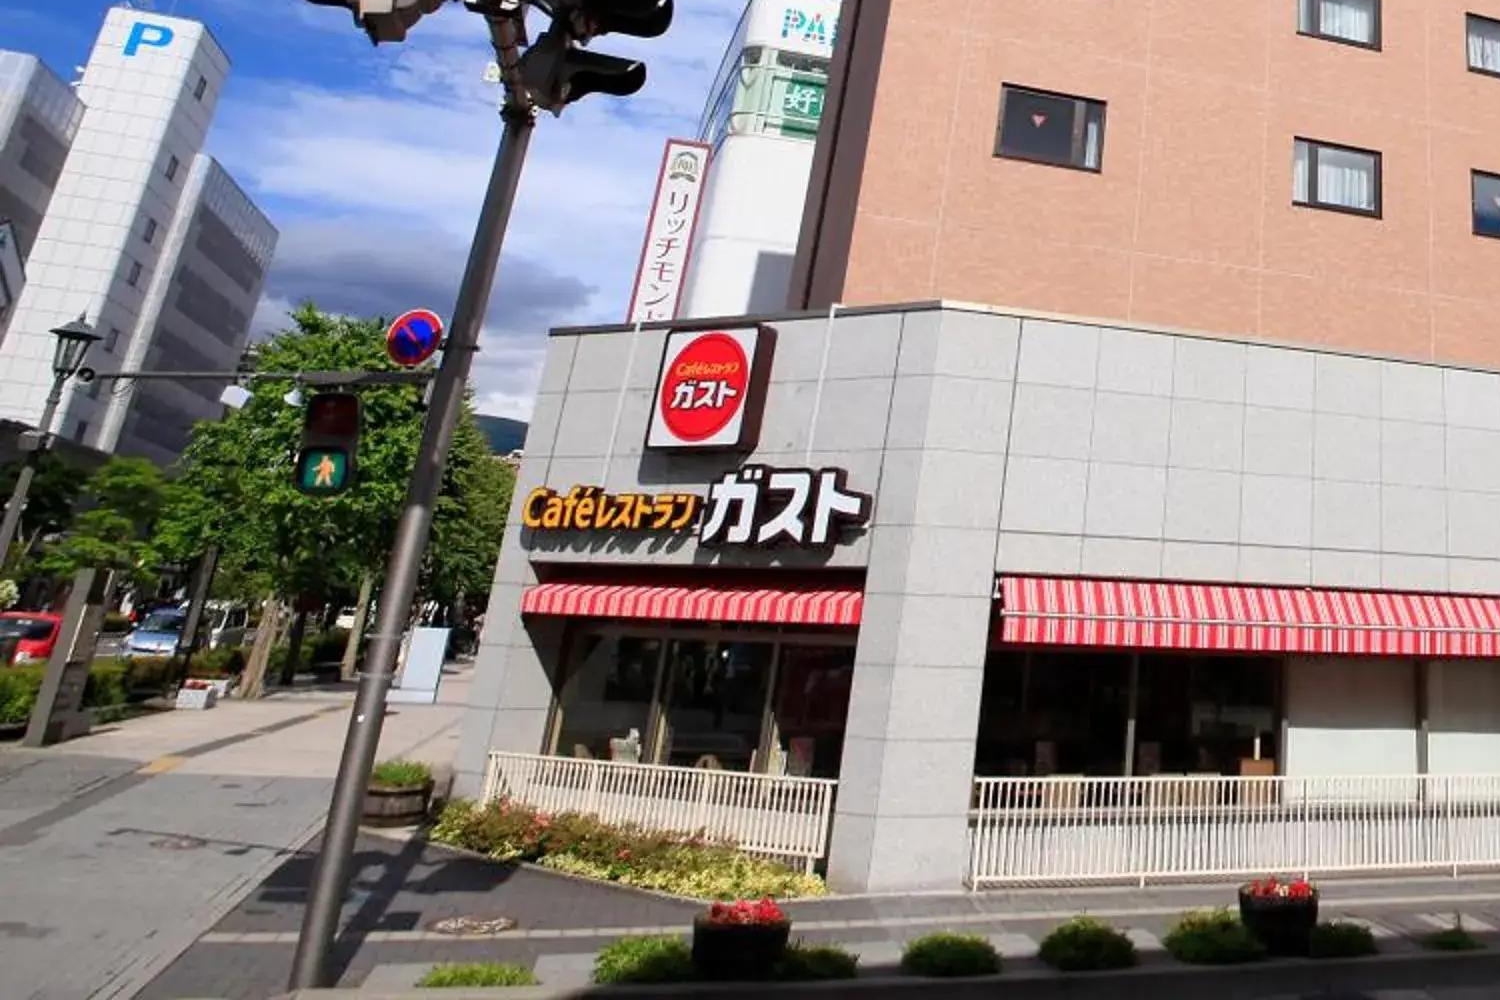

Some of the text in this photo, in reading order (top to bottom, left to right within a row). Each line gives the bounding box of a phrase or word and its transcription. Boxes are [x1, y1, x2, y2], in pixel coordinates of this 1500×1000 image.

[123, 21, 175, 56] P
[669, 378, 738, 409] ガスト
[701, 468, 862, 545] ガスト
